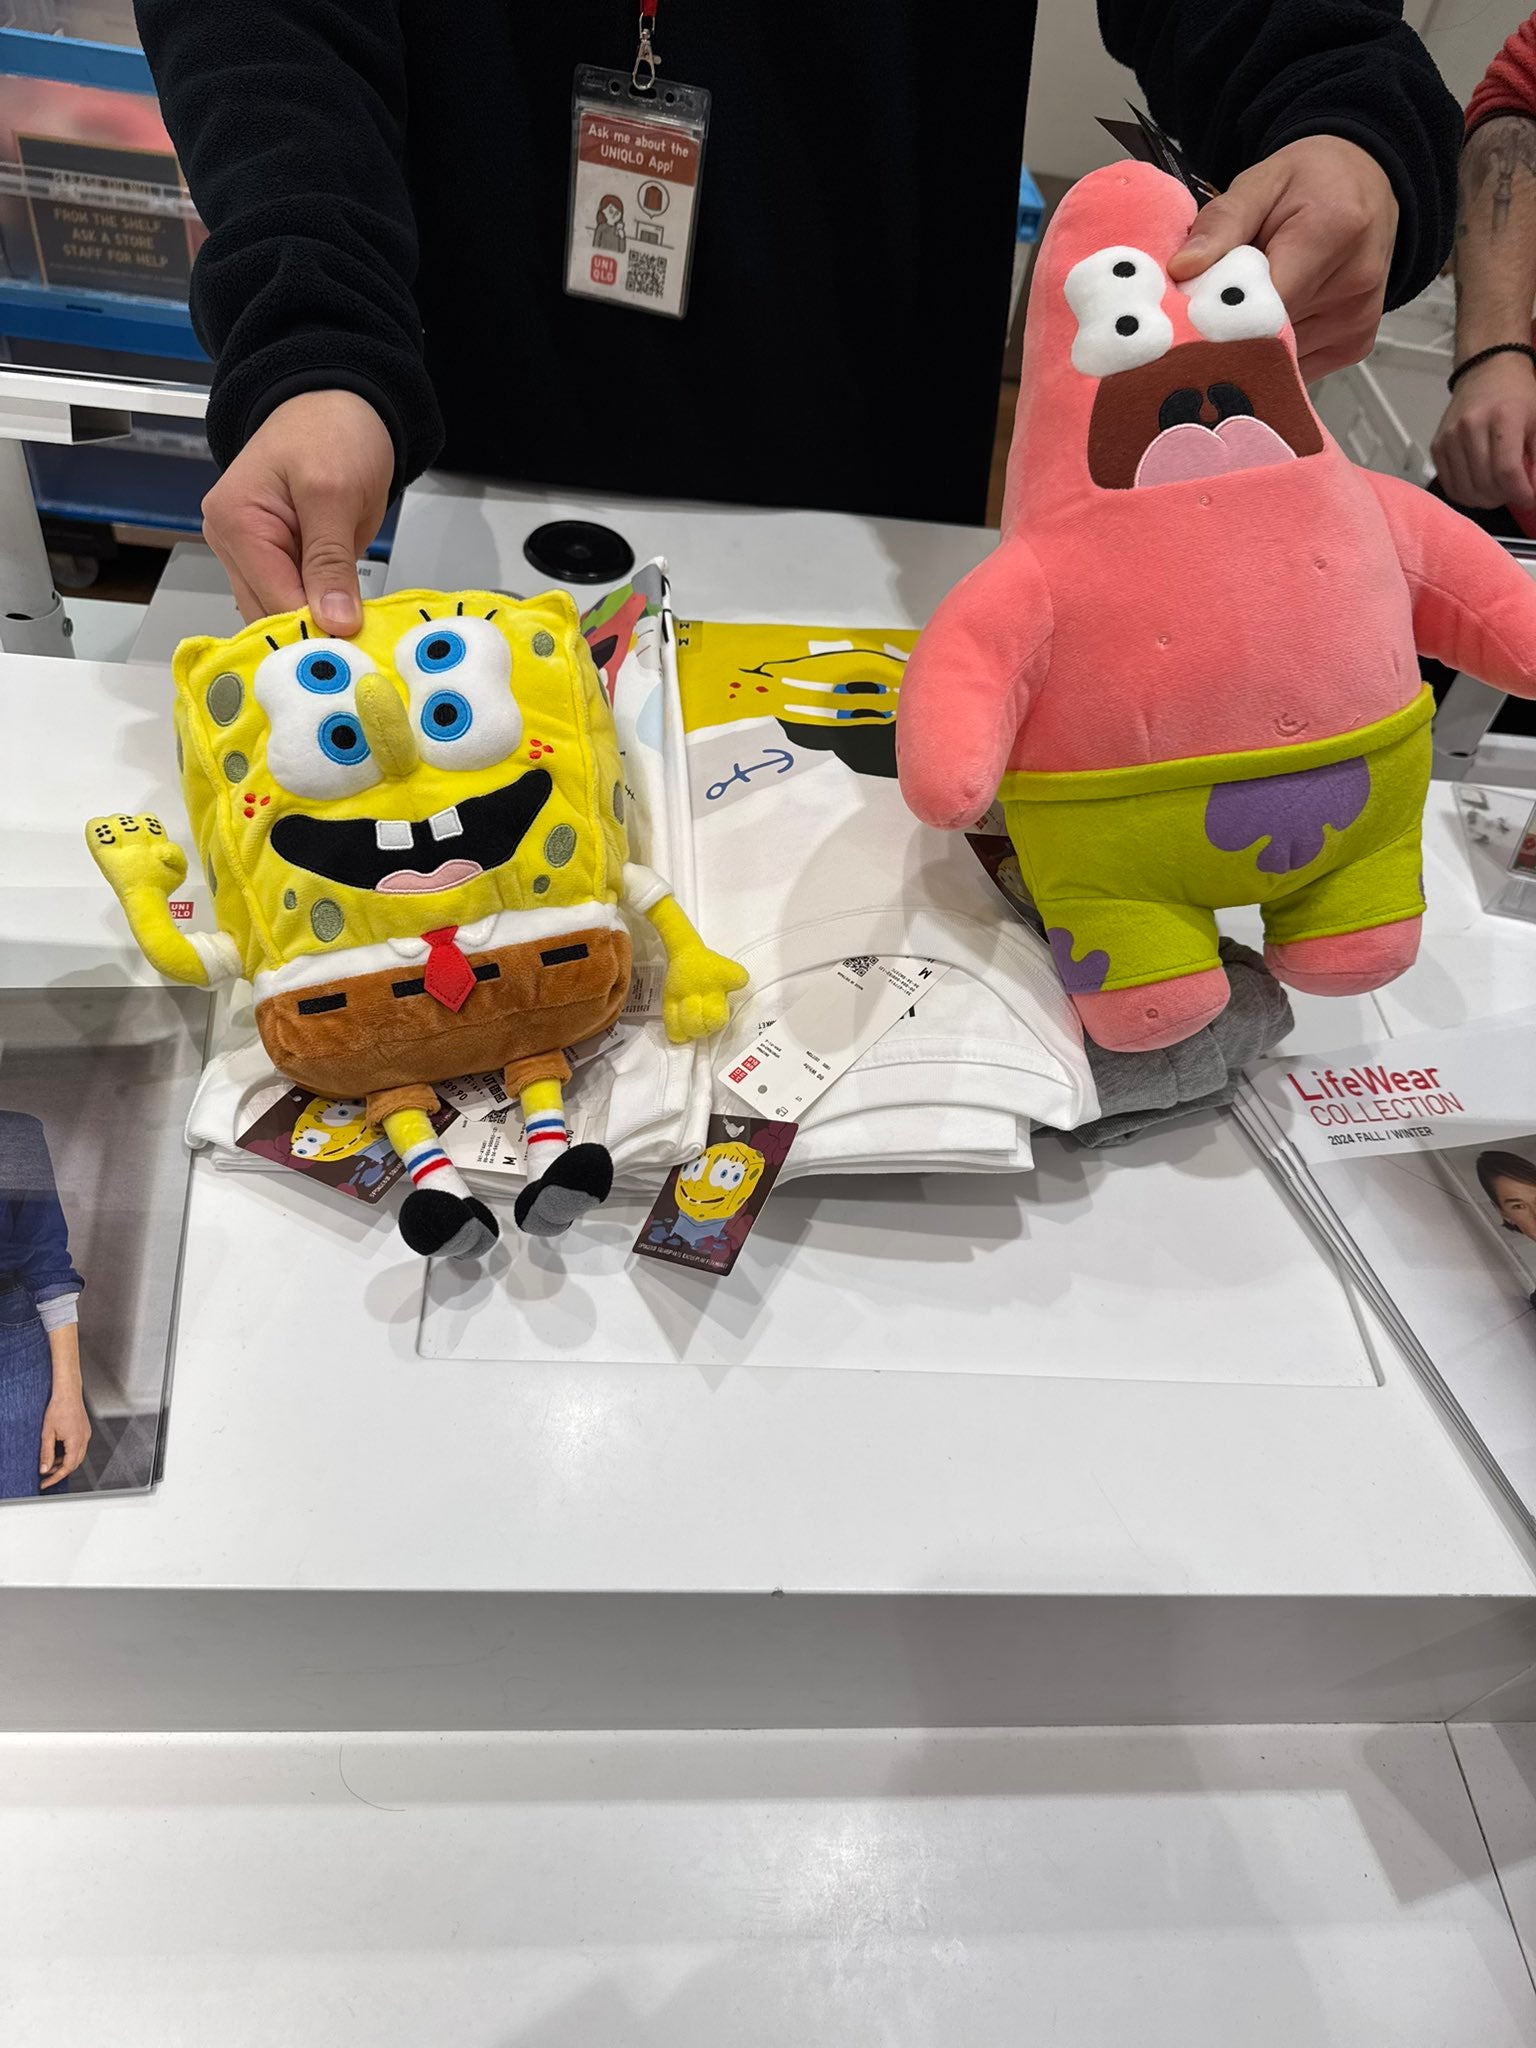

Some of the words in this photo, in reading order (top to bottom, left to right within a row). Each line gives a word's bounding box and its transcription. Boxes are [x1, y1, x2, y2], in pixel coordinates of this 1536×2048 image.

[588, 124, 609, 140] Ask
[614, 133, 631, 144] me
[635, 134, 666, 152] about
[671, 143, 689, 157] the
[601, 145, 643, 165] UNIQLO
[649, 157, 673, 173] App!
[93, 214, 118, 227] THE
[72, 228, 95, 242] ASK
[101, 232, 110, 244] A
[114, 233, 154, 249] STORE
[63, 245, 102, 260] STAFF
[107, 250, 131, 263] FOR
[135, 253, 168, 268] HELP
[594, 258, 614, 270] UNI
[592, 269, 614, 282] QLO
[917, 965, 932, 980] M
[801, 1061, 817, 1075] White
[1287, 1065, 1442, 1102] LifeWear
[1310, 1092, 1465, 1126] COLLECTION
[1327, 1133, 1355, 1146] 2024
[1356, 1132, 1384, 1143] FALL
[1392, 1126, 1434, 1139] WINTER
[501, 1154, 517, 1167] M
